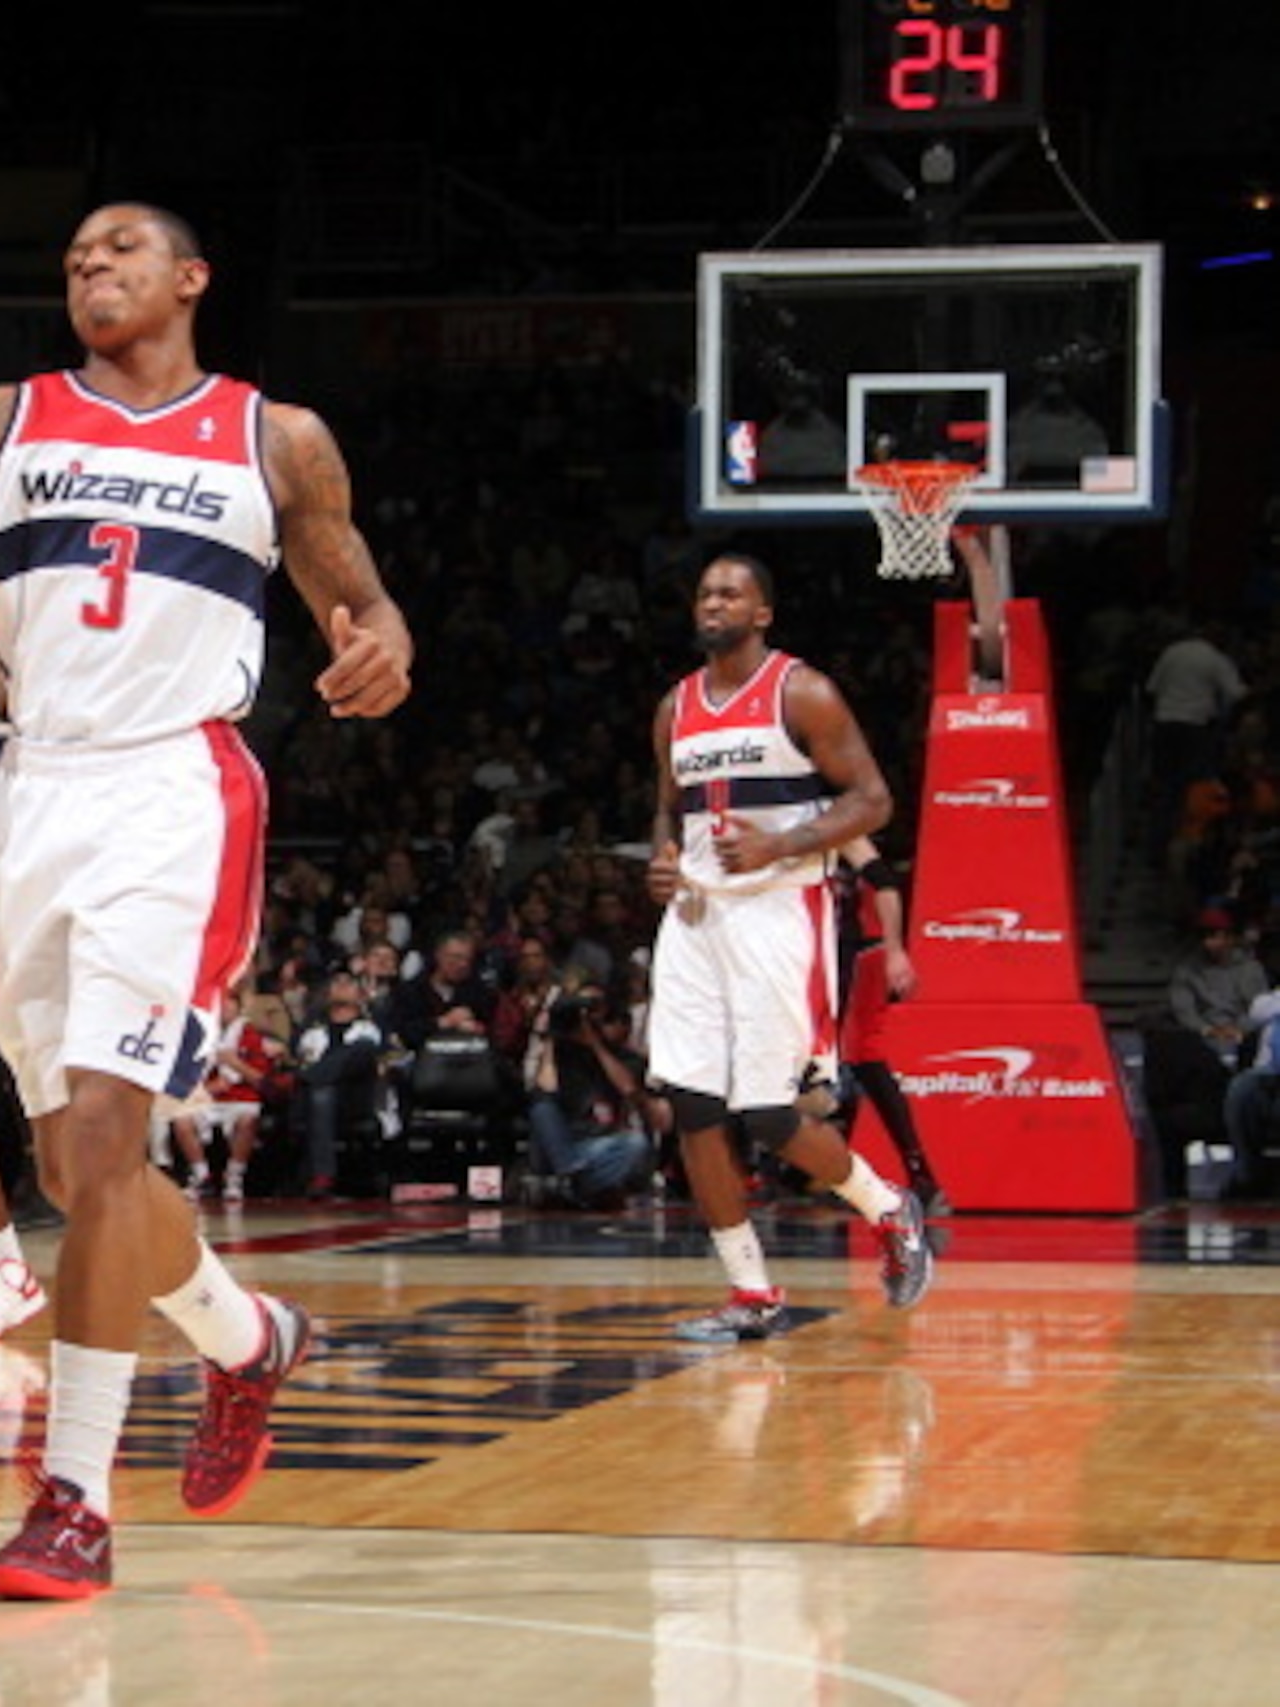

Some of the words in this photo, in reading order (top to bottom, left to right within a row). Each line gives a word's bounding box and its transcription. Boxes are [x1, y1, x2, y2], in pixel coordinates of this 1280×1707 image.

[890, 19, 999, 111] 24
[81, 522, 141, 630] 3
[1041, 1079, 1106, 1098] Bank
